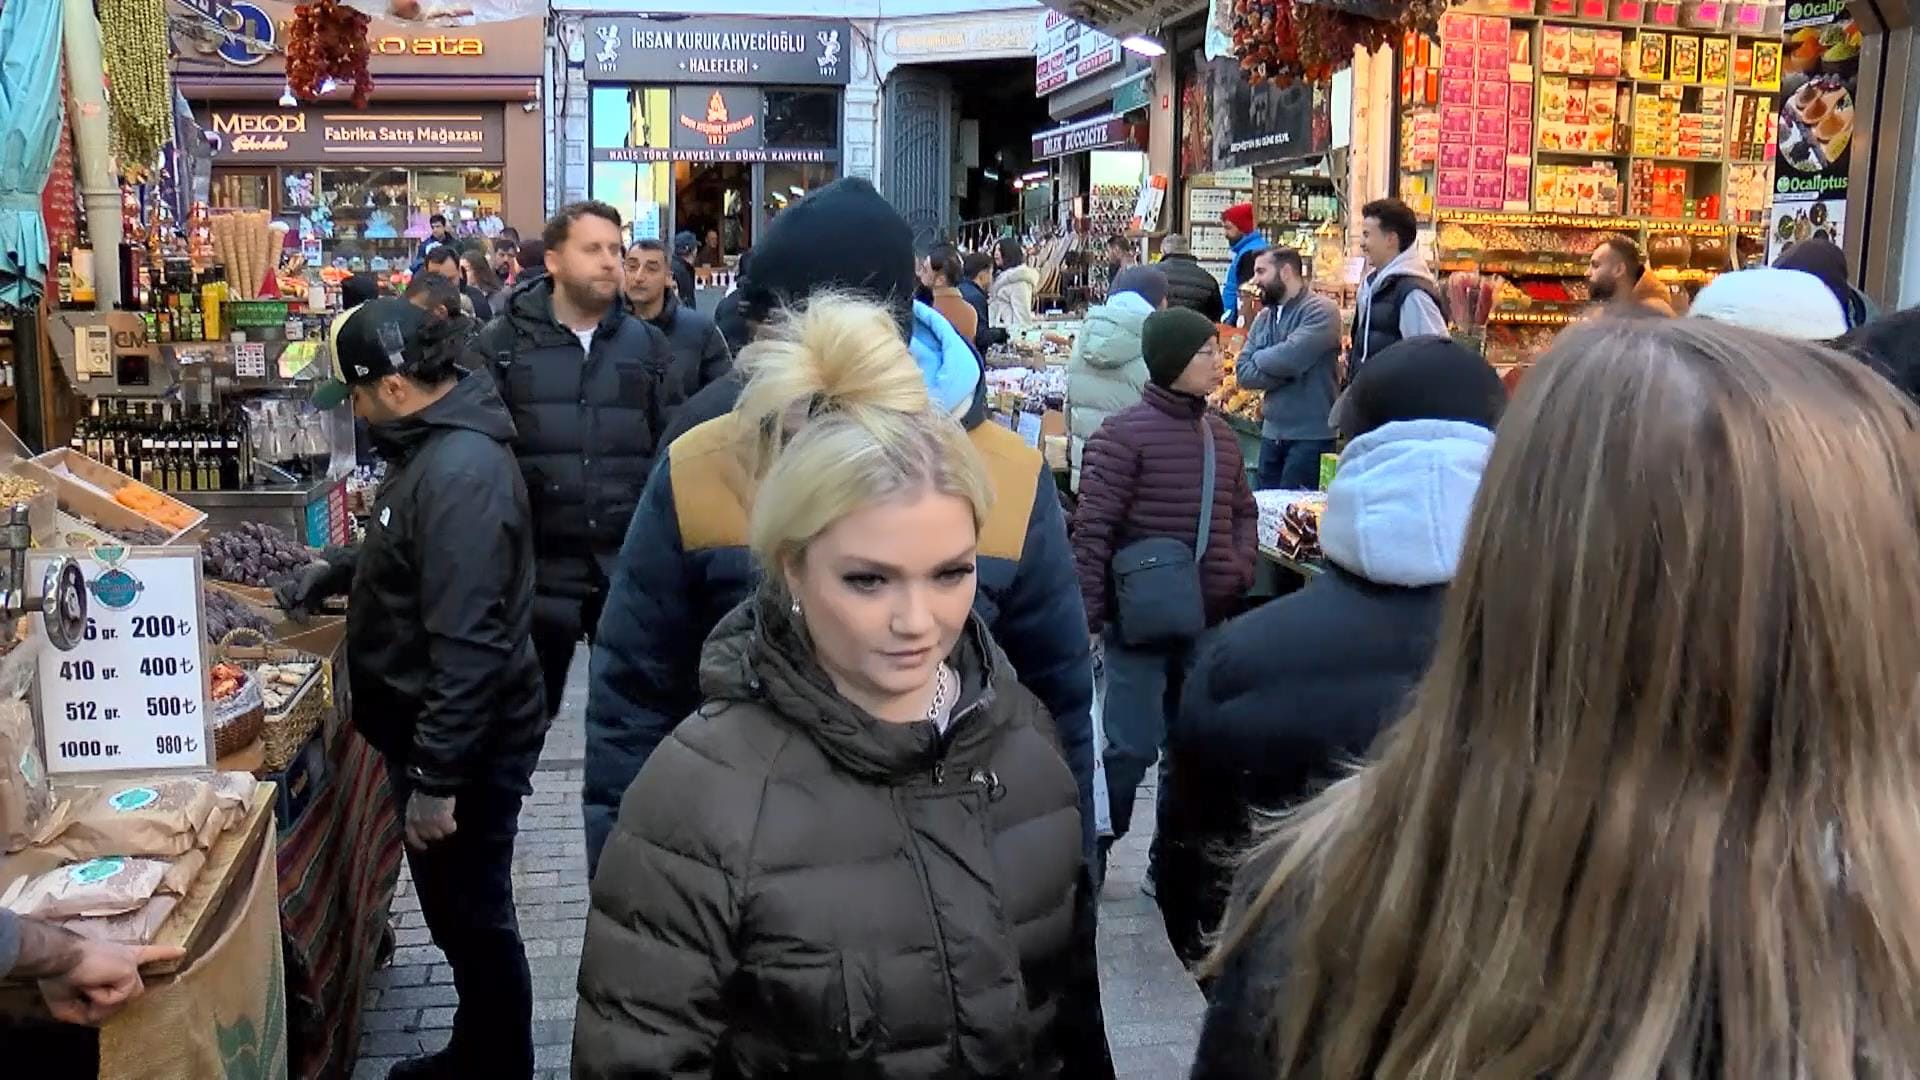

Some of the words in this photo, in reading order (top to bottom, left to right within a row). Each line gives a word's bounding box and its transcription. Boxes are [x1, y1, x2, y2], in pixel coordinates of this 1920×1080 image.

[632, 27, 673, 49] İHSAN
[676, 31, 805, 52] KURUKAHVECİOĞLU
[689, 57, 748, 74] HALEFLERİ
[324, 127, 376, 141] Fabrika
[379, 127, 414, 144] Satış
[417, 126, 483, 144] Mağazası
[609, 150, 638, 160] HALİS
[643, 149, 668, 160] TÜRK
[672, 150, 714, 161] KAHVESİ
[719, 152, 731, 161] VE
[736, 150, 767, 161] DÜNYA
[772, 151, 824, 161] KAHVELERİ
[101, 628, 119, 640] gr.
[60, 660, 95, 681] 410
[102, 667, 119, 680] gr.
[66, 701, 97, 721] 512
[104, 708, 121, 720] gr.
[59, 741, 101, 758] 1000
[105, 744, 121, 756] gr.
